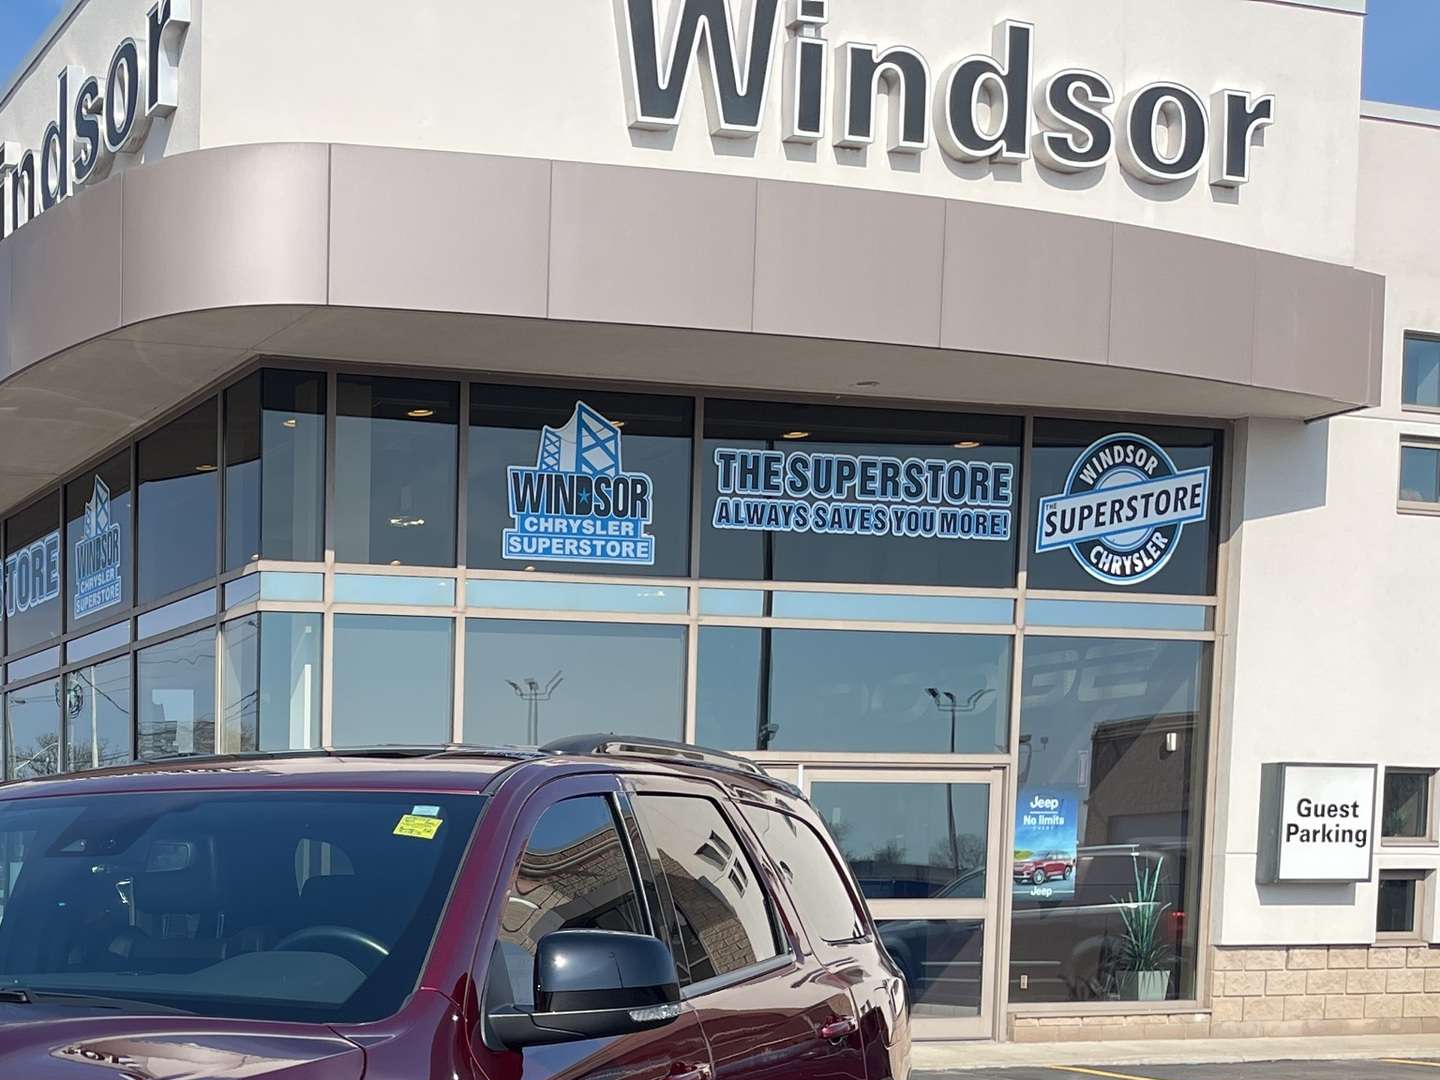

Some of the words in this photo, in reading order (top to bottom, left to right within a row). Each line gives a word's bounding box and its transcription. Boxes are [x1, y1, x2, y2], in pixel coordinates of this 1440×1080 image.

[616, 0, 1276, 188] Windsor
[717, 451, 782, 492] THE
[786, 453, 1011, 503] SUPERSTORE
[1078, 444, 1159, 486] WINDSOR
[511, 471, 649, 519] WINDSOR
[1046, 502, 1057, 510] THE
[715, 500, 809, 528] ALWAYS
[813, 505, 887, 532] SAVES
[893, 509, 936, 534] YOU
[940, 512, 1008, 537] MORE!
[1044, 482, 1203, 538] SUPERSTORE
[524, 517, 635, 536] CHRYSLER
[77, 527, 119, 580] WINDSOR
[509, 536, 649, 558] SUPERSTORE
[1089, 531, 1169, 575] CHRYSLER
[80, 567, 115, 594] CHRYSLER
[76, 583, 120, 613] SUPERSTORE
[1029, 795, 1059, 810] Jeep
[1296, 798, 1360, 818] Guest
[1023, 815, 1037, 826] No
[1038, 815, 1065, 826] limits
[1285, 823, 1368, 848] Parking
[1030, 885, 1053, 898] Jeep
